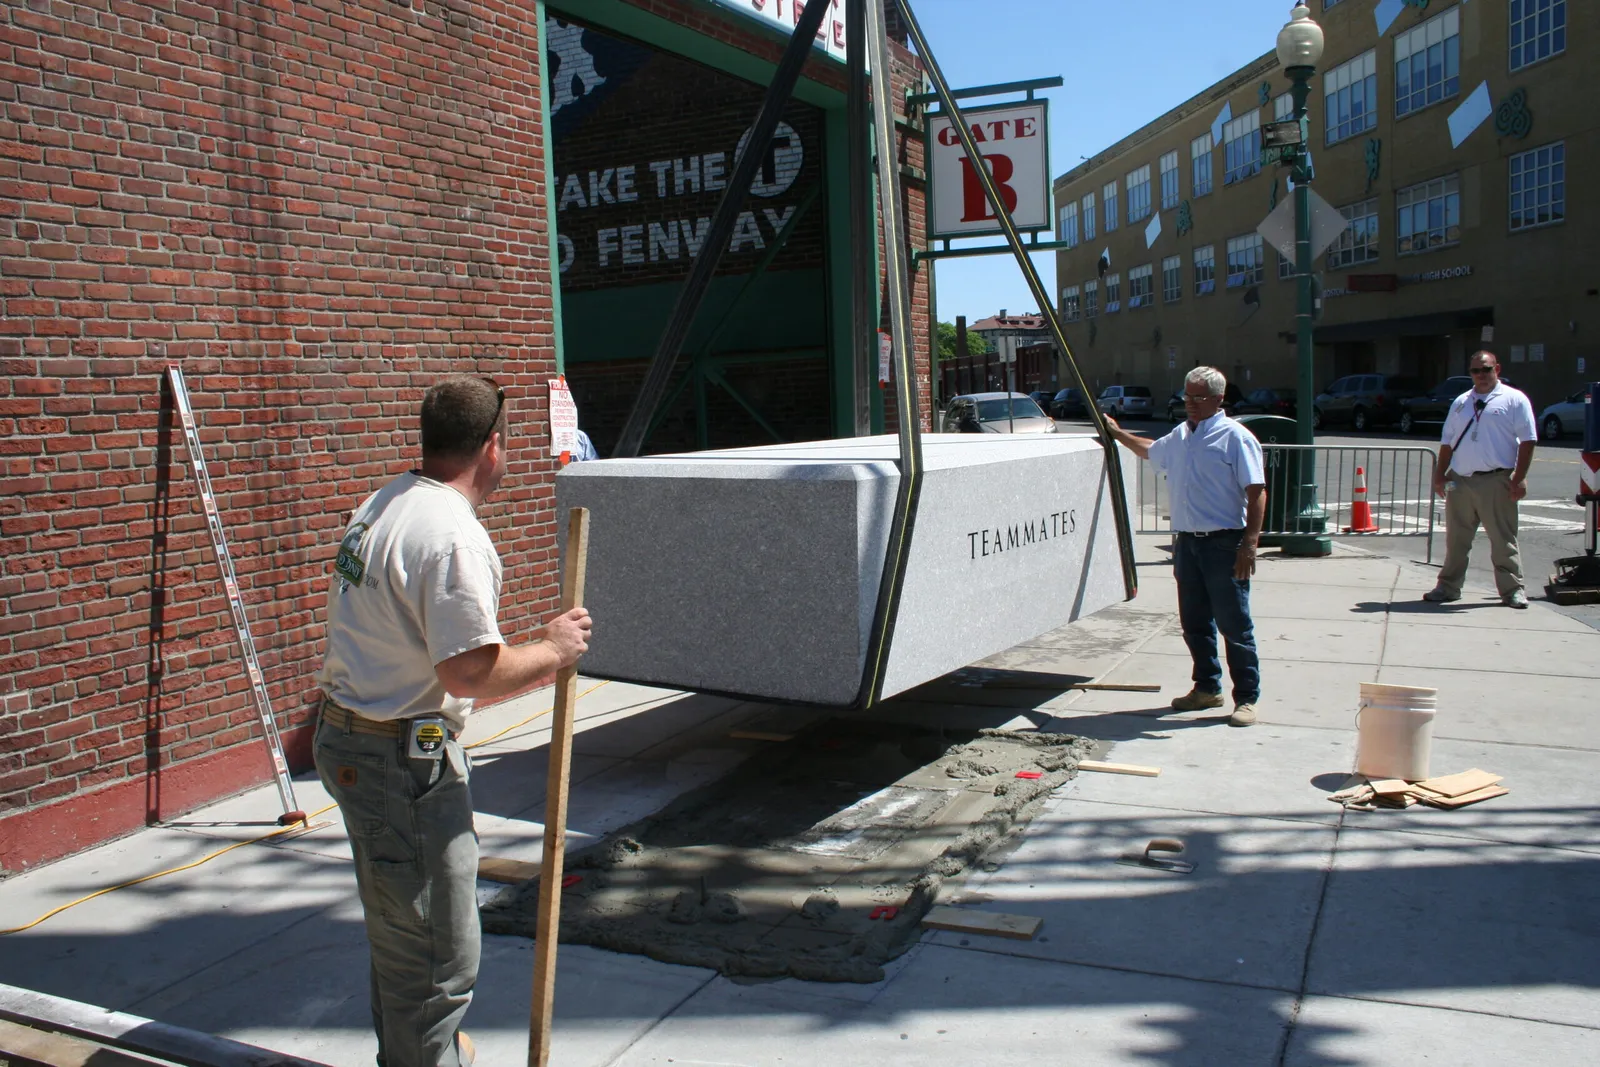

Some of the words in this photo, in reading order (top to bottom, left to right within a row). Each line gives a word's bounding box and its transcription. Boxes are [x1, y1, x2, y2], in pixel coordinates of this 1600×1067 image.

[937, 117, 1037, 147] GATE
[553, 165, 639, 211] AKE
[650, 152, 727, 197] THE
[958, 154, 1018, 222] B
[1422, 271, 1440, 281] HIGH
[1441, 265, 1472, 279] SCHOOL
[559, 391, 568, 399] NO
[967, 509, 1076, 560] TEAMMATES
